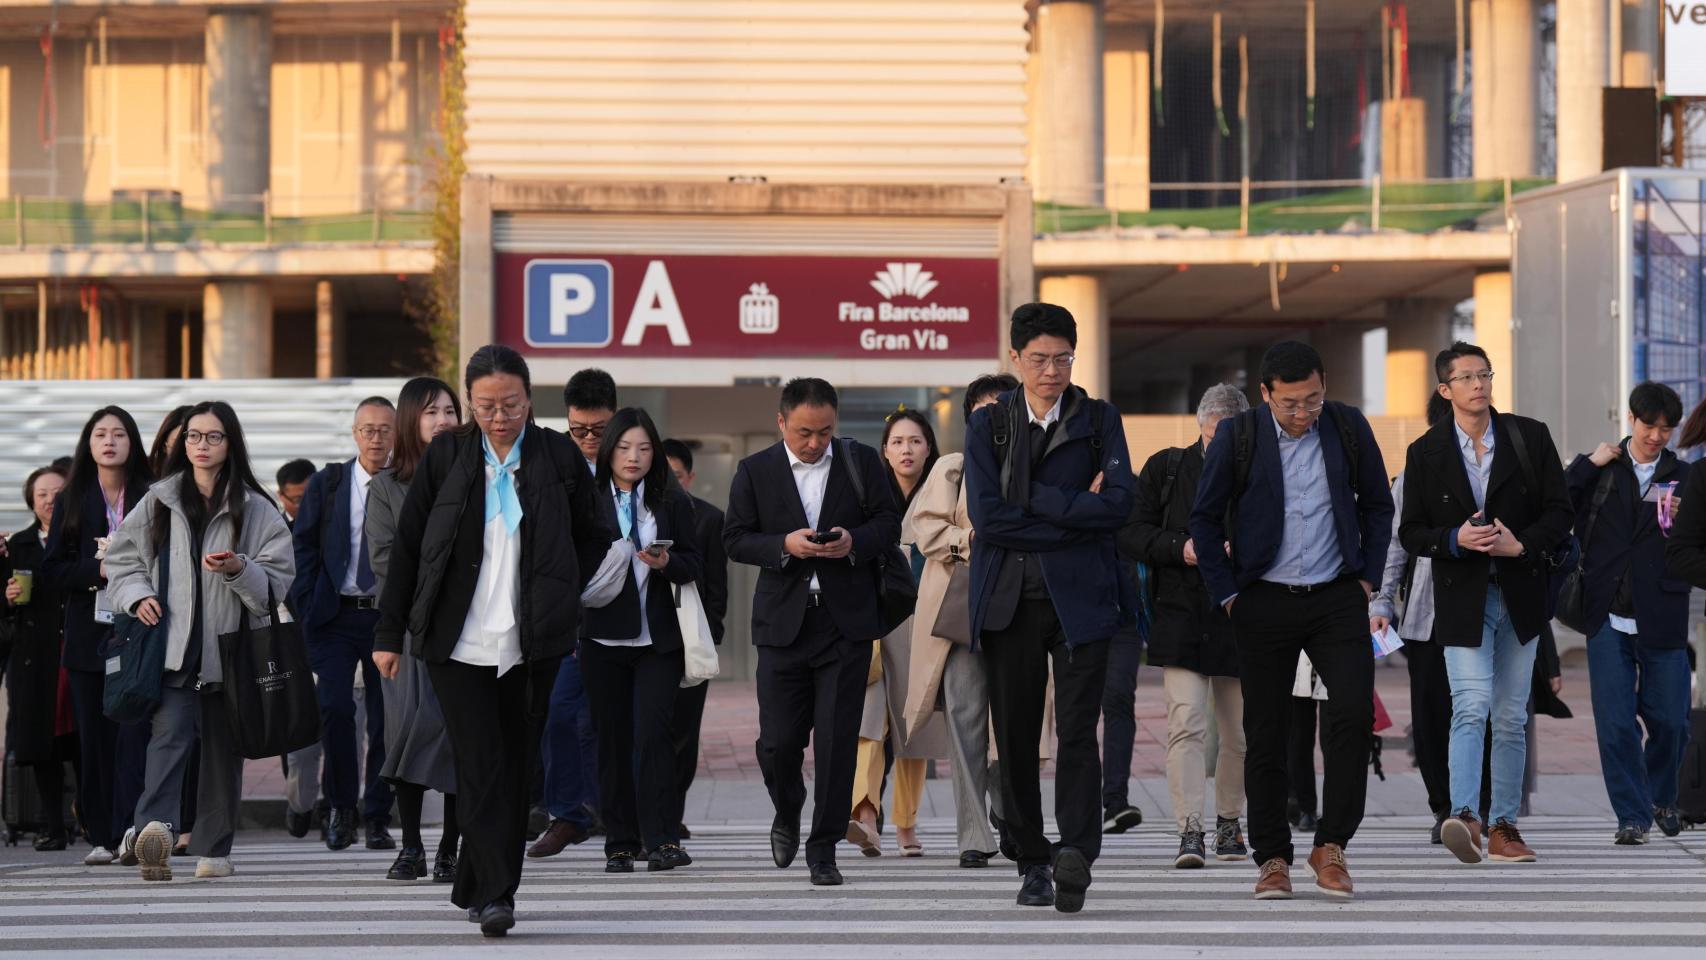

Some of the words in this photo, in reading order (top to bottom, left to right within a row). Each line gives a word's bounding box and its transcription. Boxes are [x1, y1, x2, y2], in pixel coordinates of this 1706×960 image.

[550, 273, 595, 336] P
[621, 261, 692, 346] A
[839, 302, 873, 322] Fira
[879, 301, 969, 322] Barcelona
[860, 329, 910, 350] Gran
[913, 329, 948, 350] Via
[267, 661, 278, 674] R
